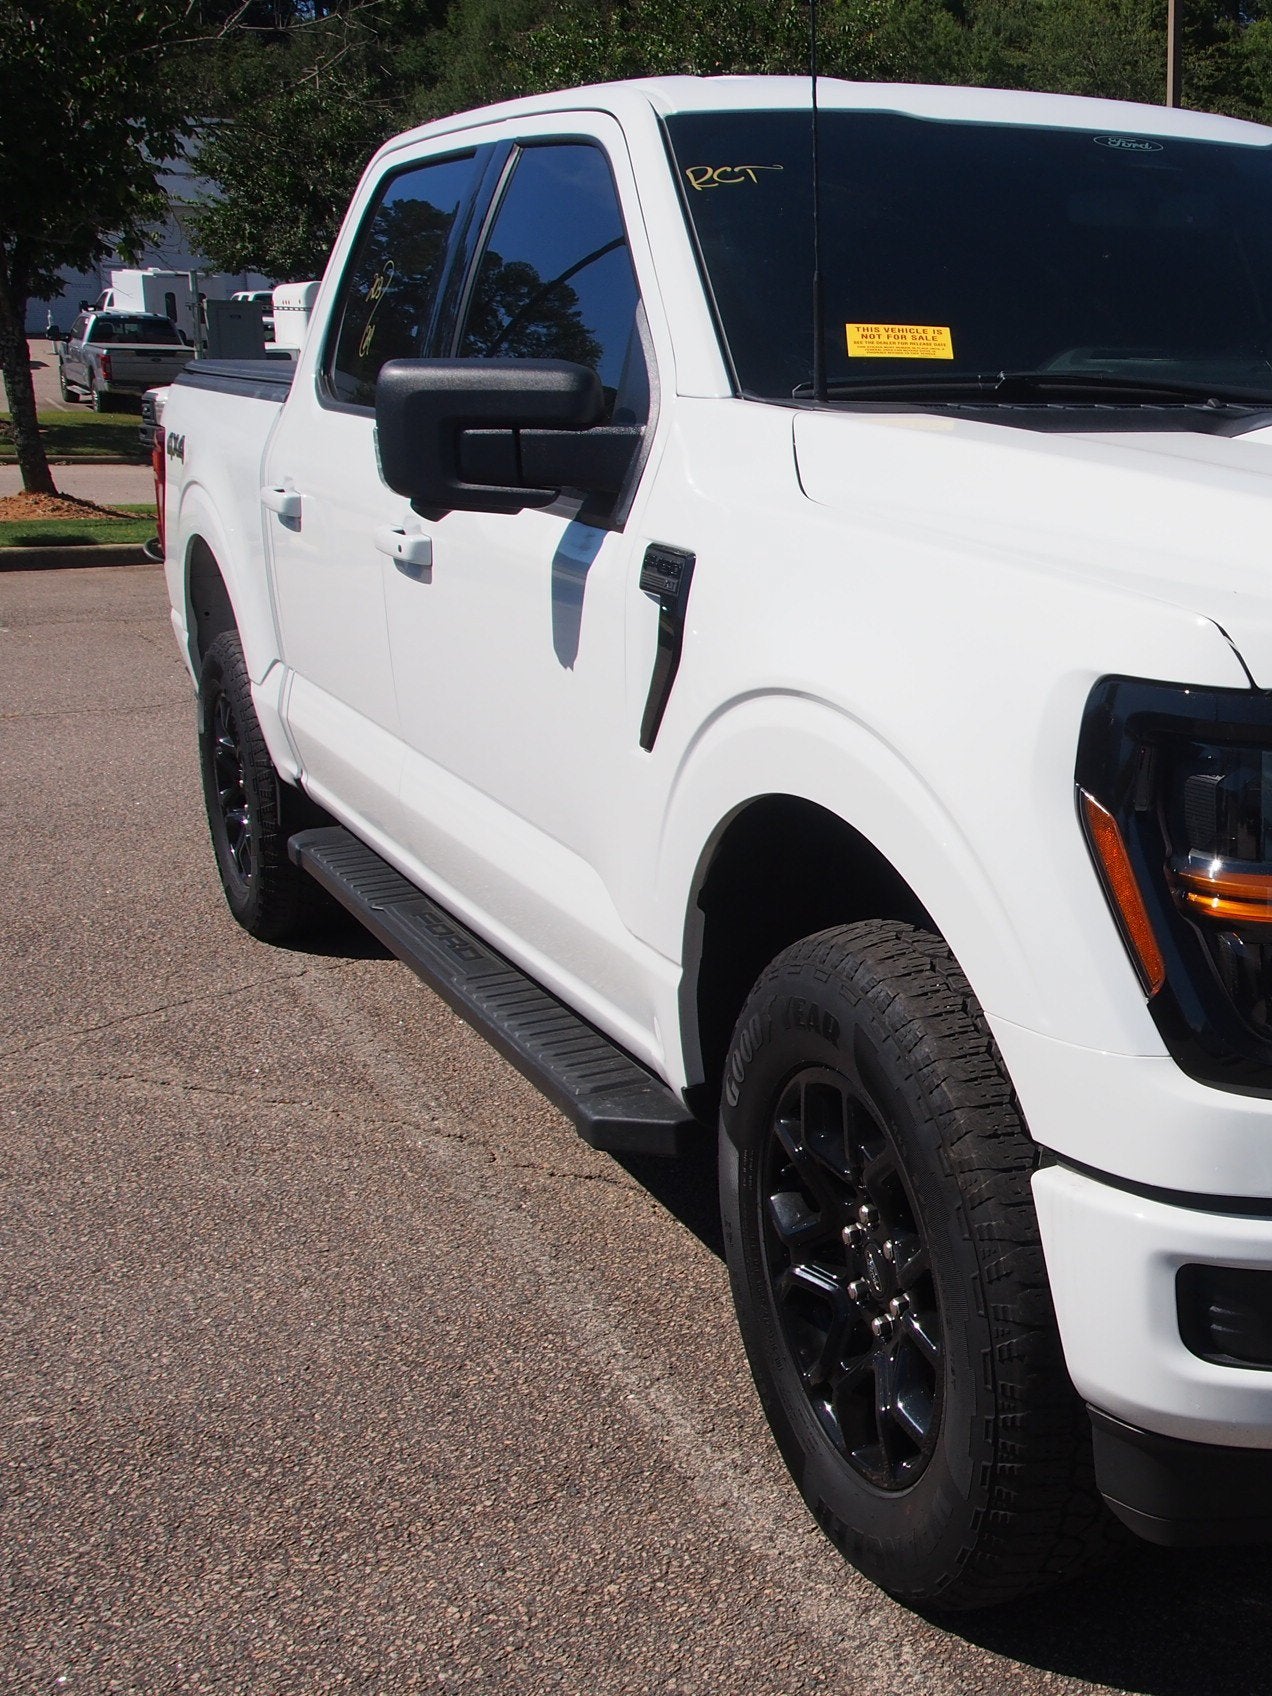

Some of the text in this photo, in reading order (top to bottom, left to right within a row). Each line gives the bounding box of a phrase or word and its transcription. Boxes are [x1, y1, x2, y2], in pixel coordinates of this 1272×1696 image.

[1107, 137, 1152, 150] Ford
[883, 327, 928, 335] VEHICLE
[886, 333, 907, 341] FOR
[911, 334, 939, 342] SALE
